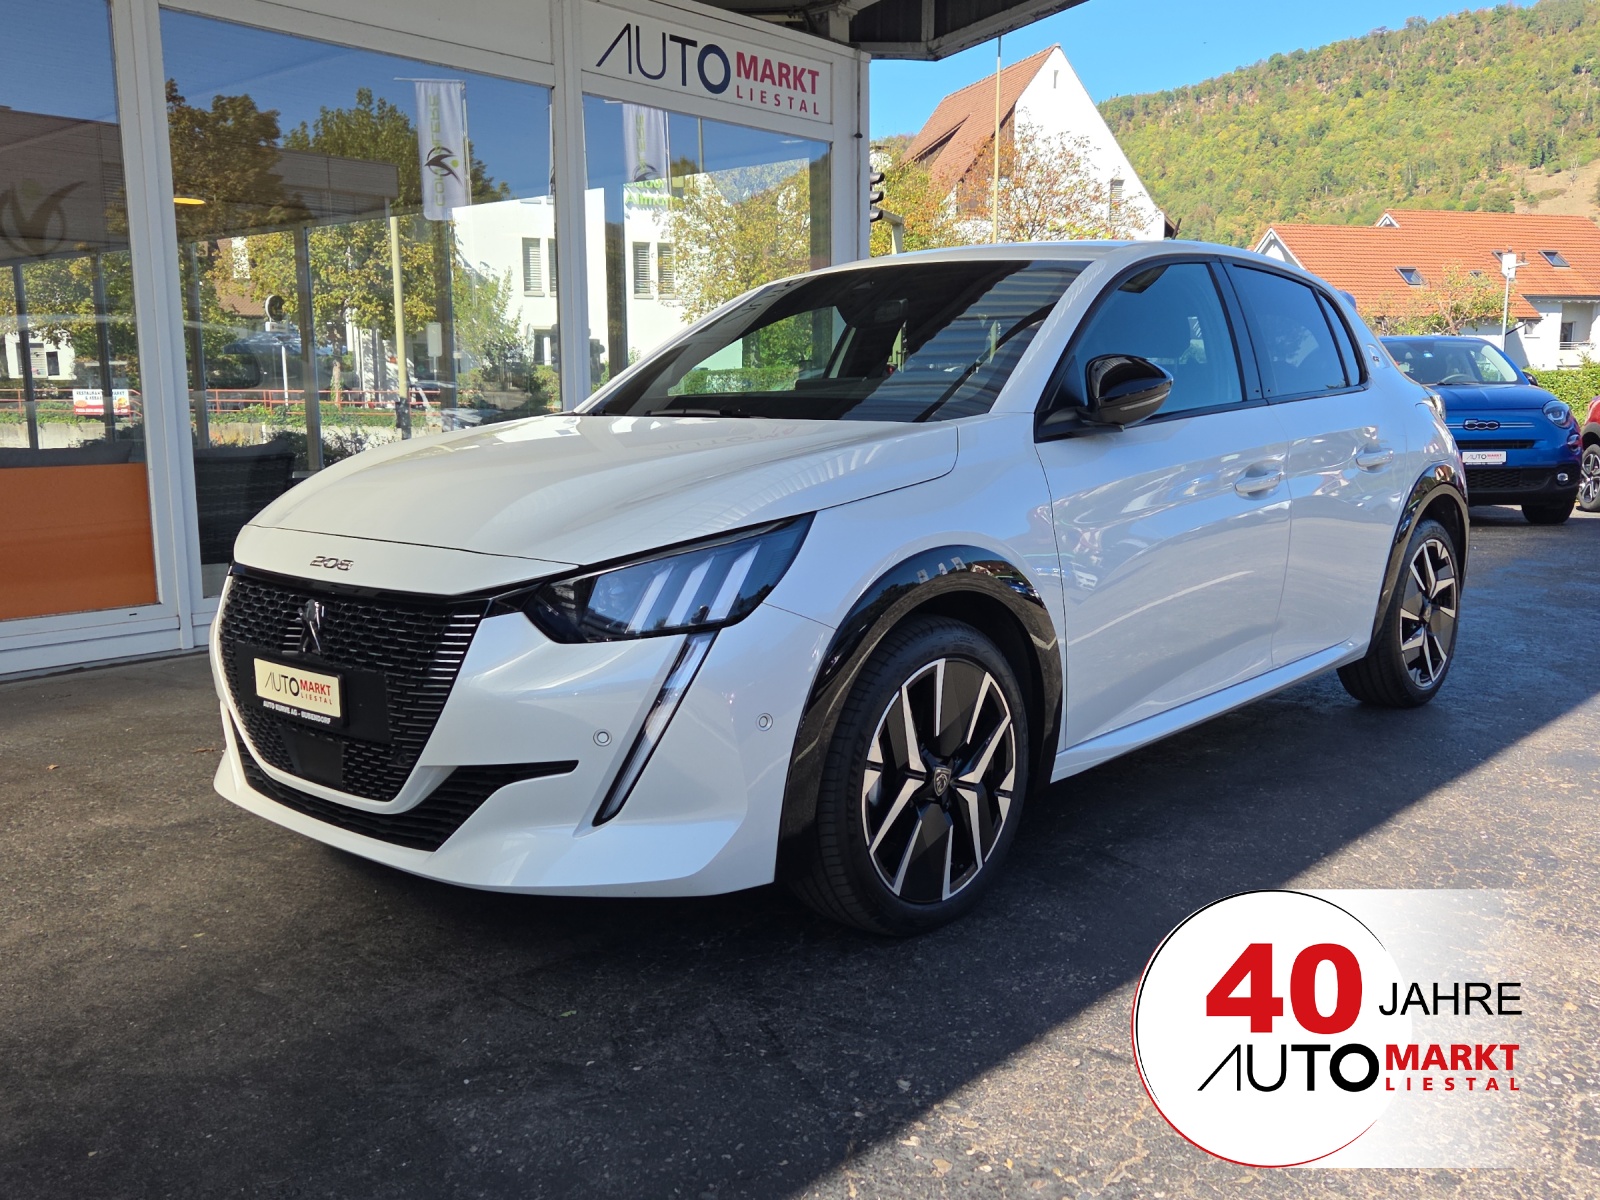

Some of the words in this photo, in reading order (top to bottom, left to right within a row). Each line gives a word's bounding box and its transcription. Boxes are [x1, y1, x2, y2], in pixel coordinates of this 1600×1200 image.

[736, 51, 819, 95] MARKT
[736, 85, 819, 115] LIESTAL
[1464, 419, 1499, 430] 500
[310, 555, 354, 571] 208
[300, 679, 331, 696] MARKT
[301, 693, 333, 705] LIESTAL
